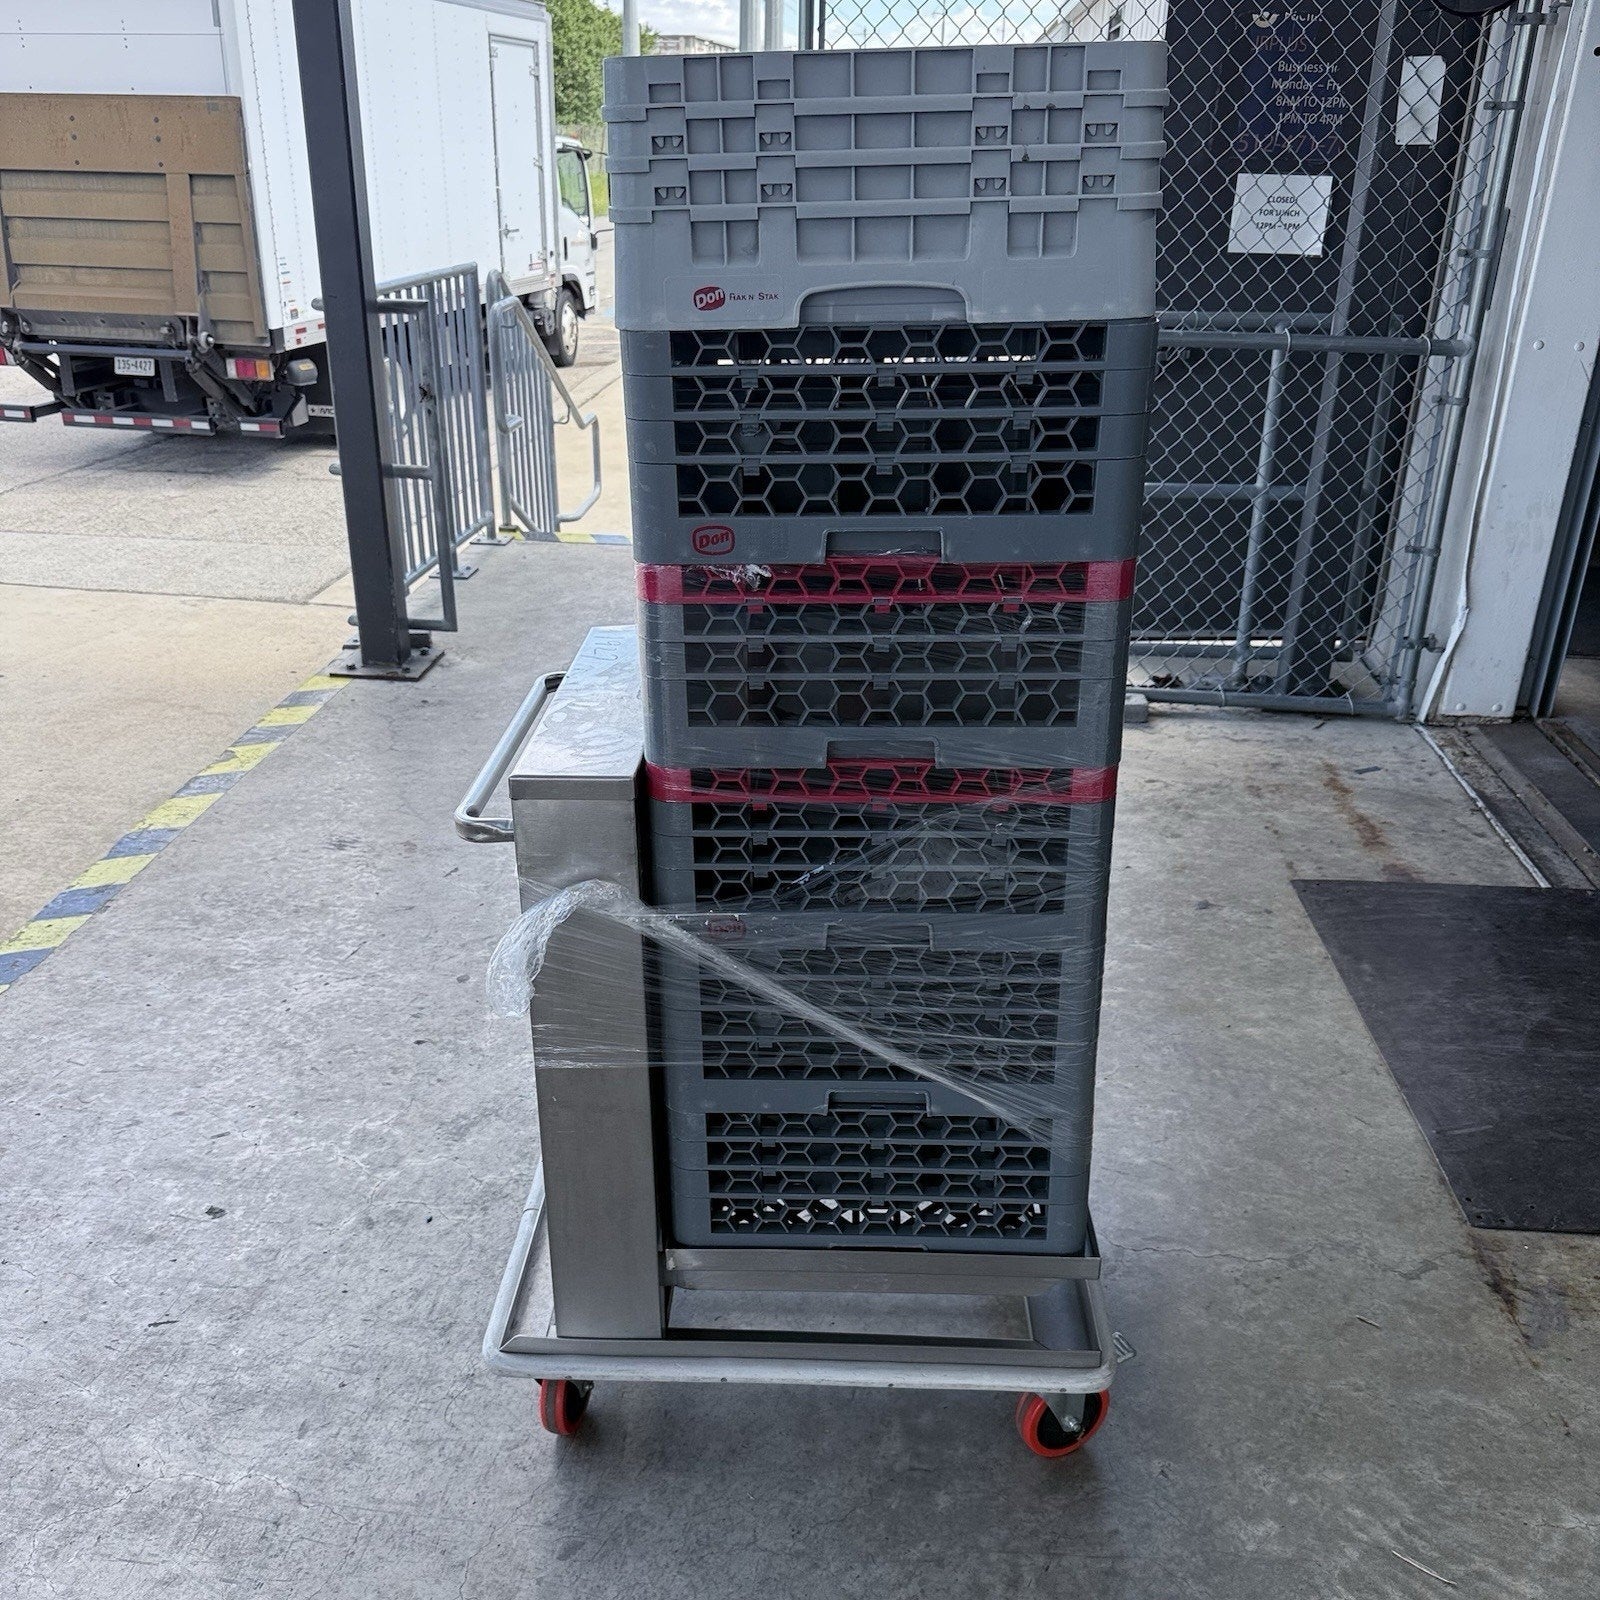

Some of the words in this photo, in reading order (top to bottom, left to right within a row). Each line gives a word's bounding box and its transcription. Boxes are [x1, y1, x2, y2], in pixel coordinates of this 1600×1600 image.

[1278, 60, 1323, 73] Business
[1275, 96, 1300, 107] 8AM
[1303, 96, 1317, 107] TO
[1279, 113, 1300, 124] 1PM
[1303, 113, 1317, 124] TO
[1319, 113, 1342, 125] 4PM
[1267, 196, 1295, 204] CLOSED
[1260, 209, 1274, 217] FOR
[1256, 222, 1276, 230] 12PM
[1284, 223, 1300, 231] 1PM
[695, 288, 724, 309] Don
[699, 529, 730, 549] Don
